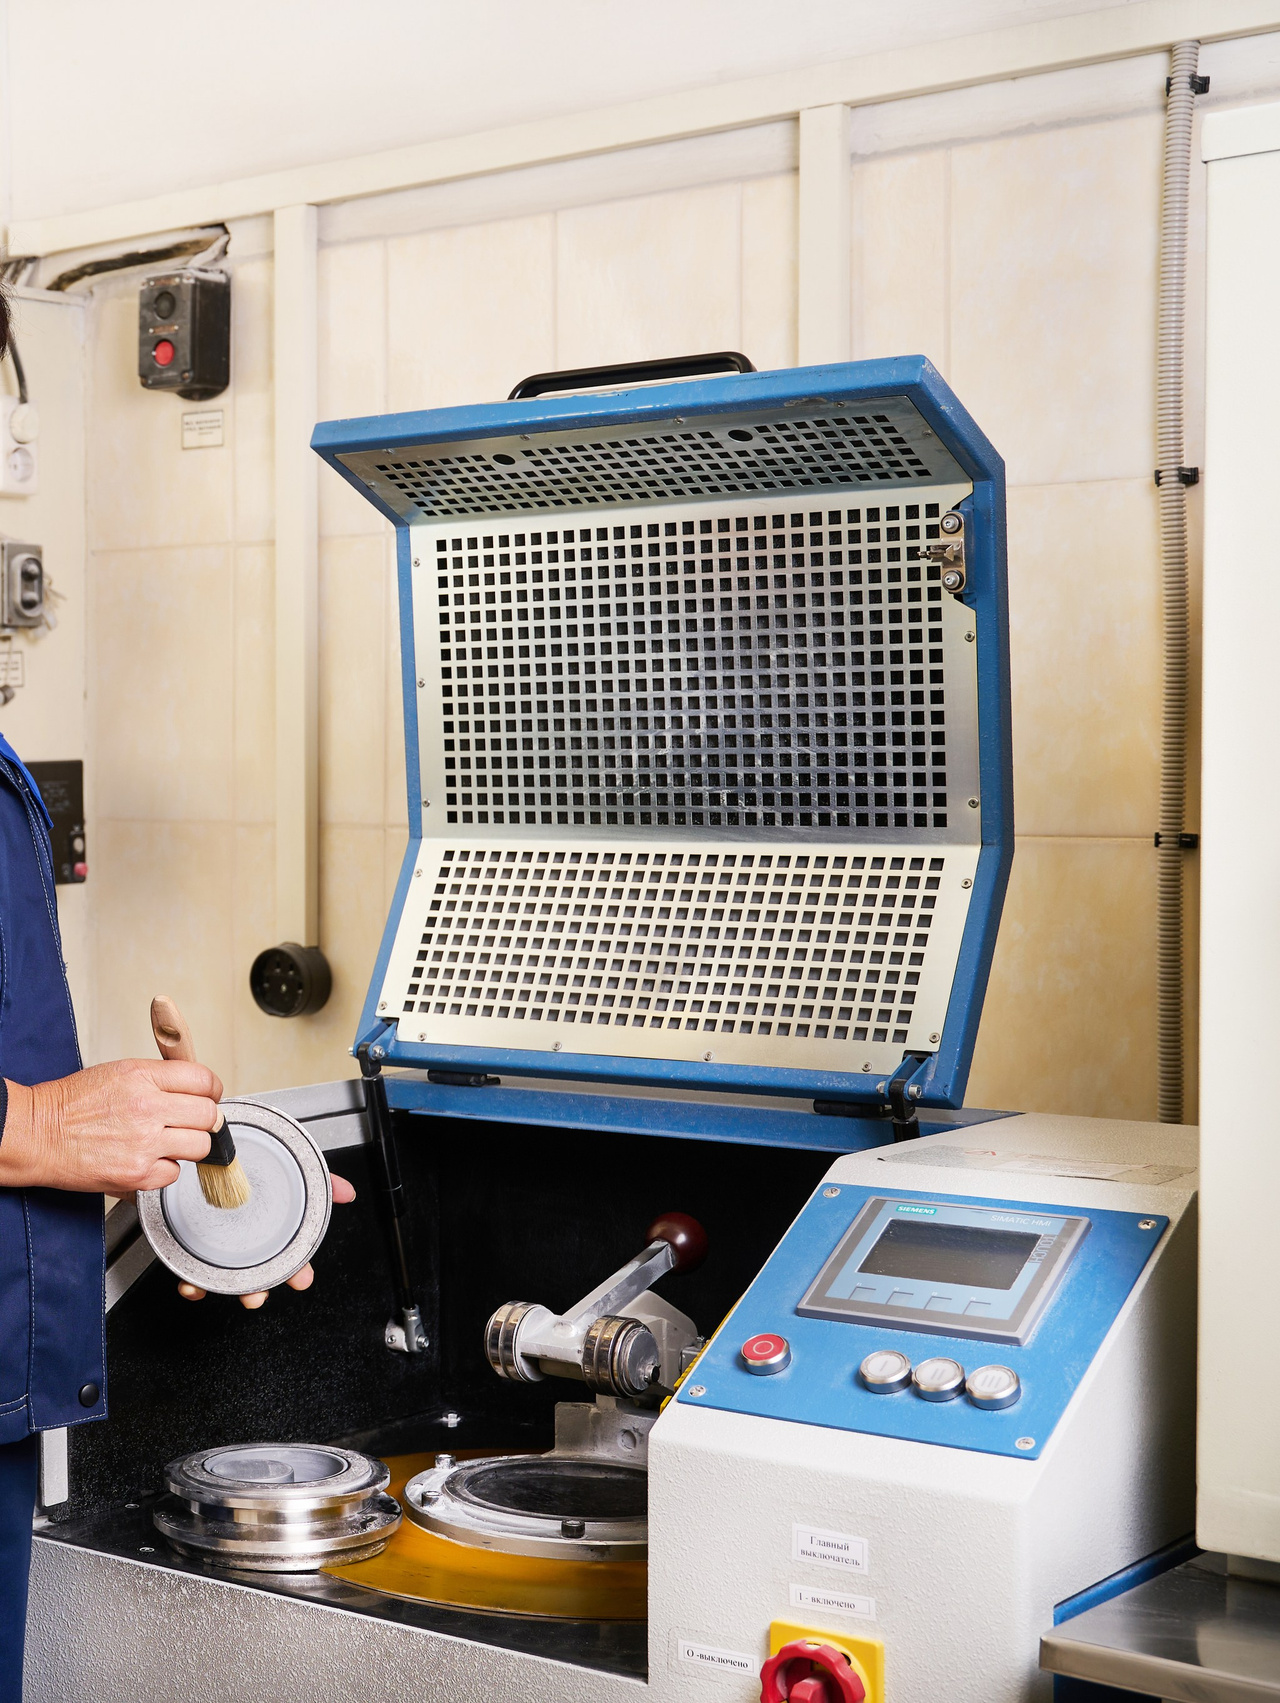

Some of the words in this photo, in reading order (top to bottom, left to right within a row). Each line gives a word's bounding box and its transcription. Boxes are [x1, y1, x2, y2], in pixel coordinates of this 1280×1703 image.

[897, 1205, 936, 1215] SIEMENS
[990, 1214, 1030, 1225] SIMATIC
[1031, 1219, 1052, 1227] HMI
[1028, 1235, 1058, 1264] TOUCH
[810, 1536, 849, 1551] Главный
[800, 1549, 860, 1566] выключатель
[811, 1596, 855, 1609] включено
